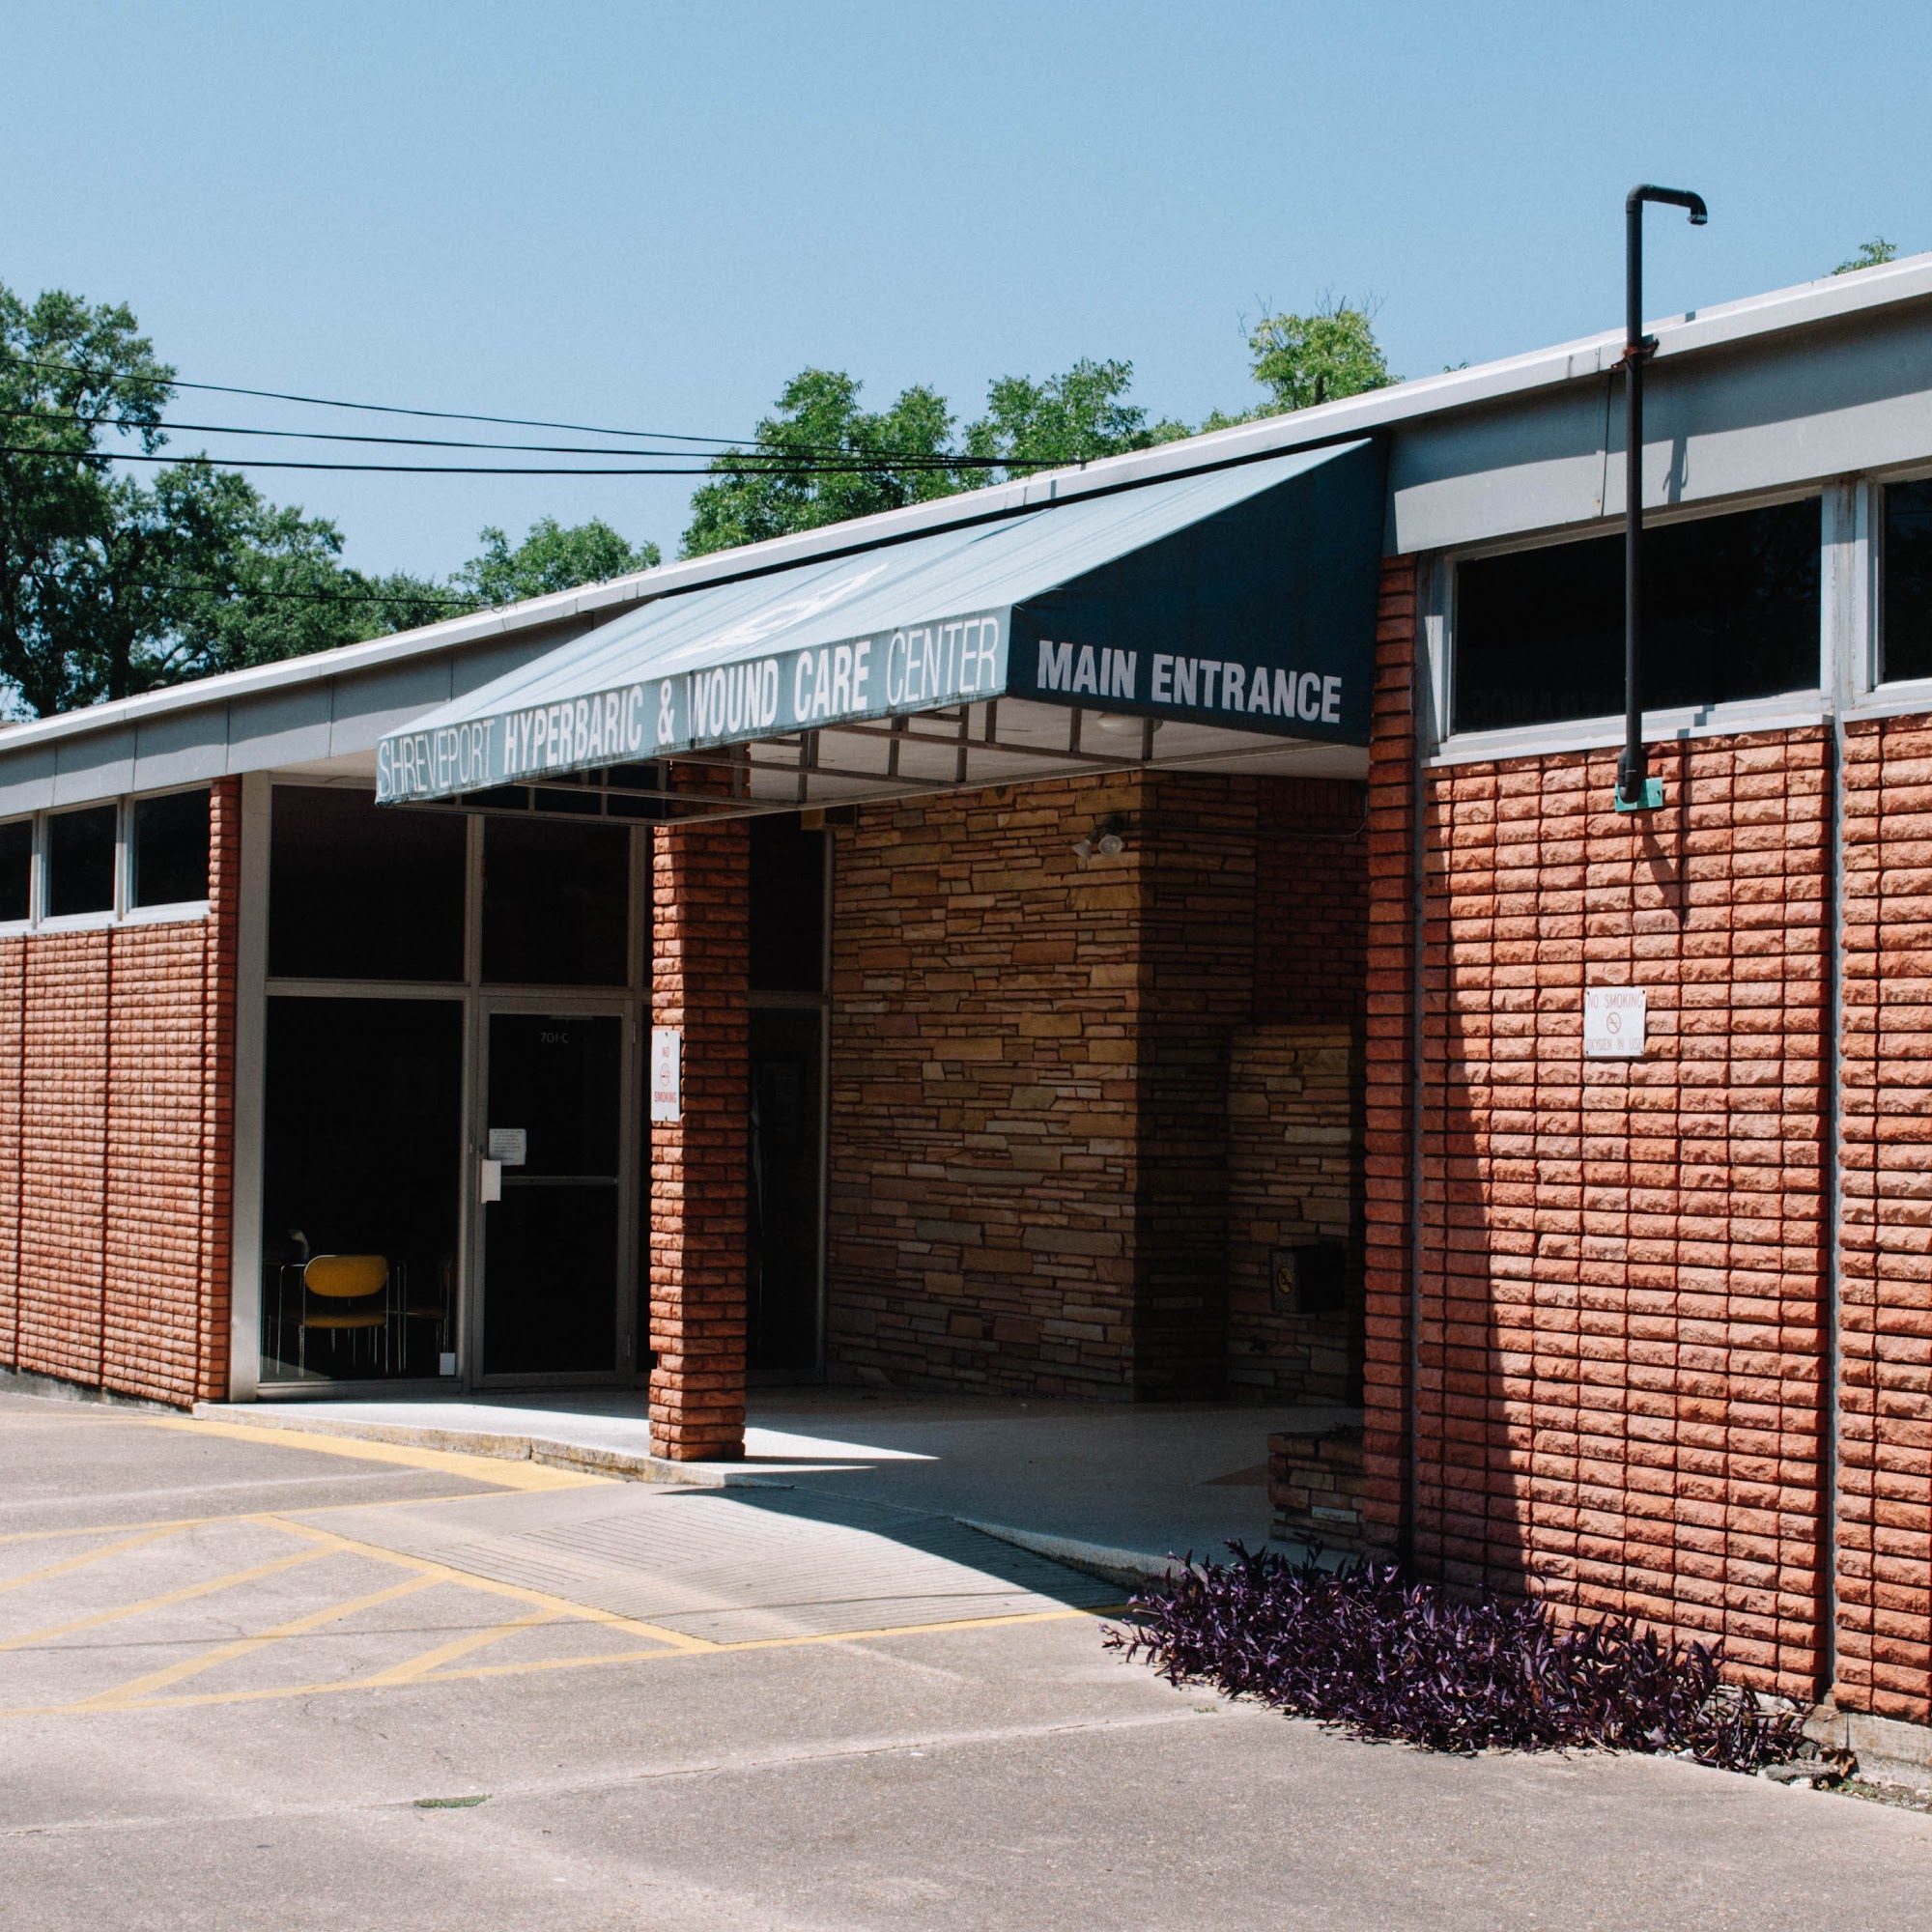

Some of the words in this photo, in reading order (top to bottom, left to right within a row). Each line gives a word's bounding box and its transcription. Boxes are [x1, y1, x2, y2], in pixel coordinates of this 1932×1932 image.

[1037, 639, 1138, 700] MAIN
[1151, 653, 1343, 724] ENTRANCE
[378, 719, 496, 796] SHREVEPORT
[503, 685, 644, 775] HYPERBARIC
[657, 678, 674, 746] &
[687, 659, 779, 738] WOUND
[793, 640, 871, 723] CARE
[886, 616, 1000, 706] CENTER
[1587, 994, 1600, 1009] NO
[1604, 993, 1643, 1009] SMOKING
[1585, 1037, 1612, 1051] OXYGEN
[1616, 1037, 1624, 1050] IN
[1629, 1037, 1643, 1050] USE
[662, 1046, 670, 1058] NO
[654, 1092, 677, 1103] SMOKING
